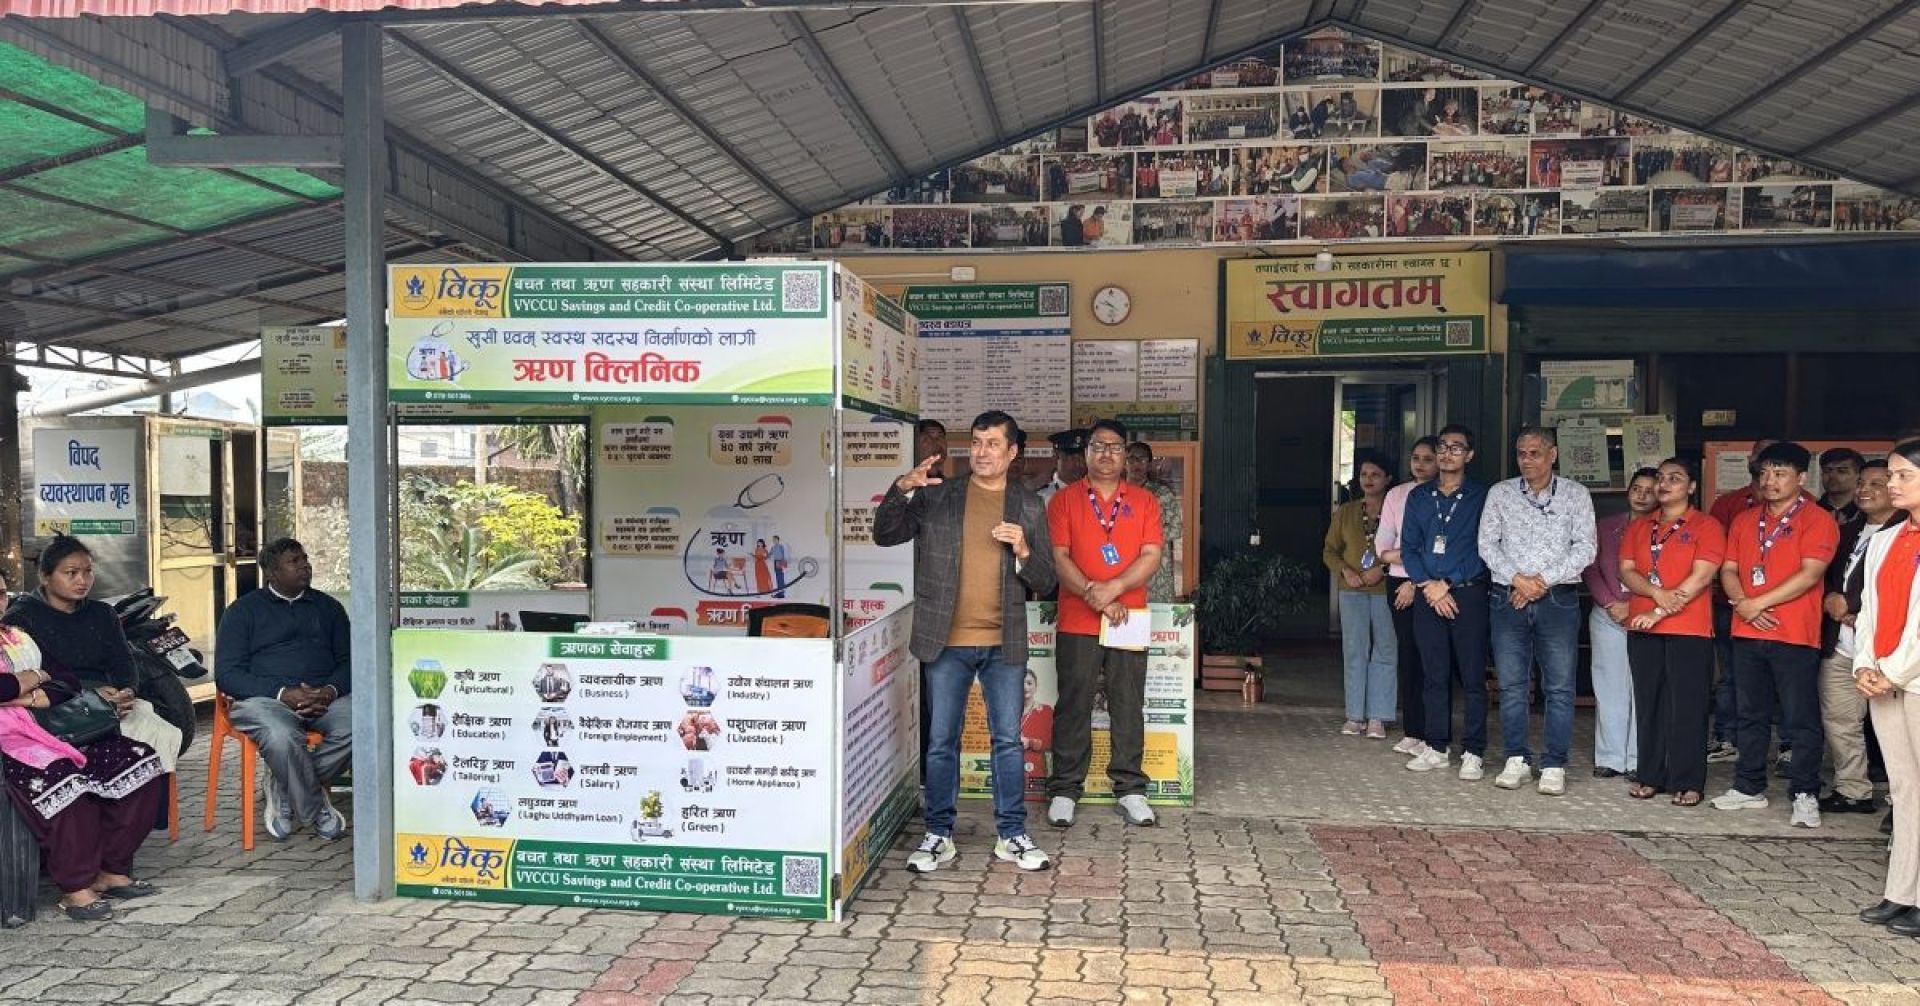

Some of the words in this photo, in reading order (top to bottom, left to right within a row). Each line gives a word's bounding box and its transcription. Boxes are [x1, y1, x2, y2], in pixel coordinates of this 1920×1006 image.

[437, 267, 502, 309] विकू
[514, 277, 544, 291] बचत
[551, 277, 577, 291] तथा
[584, 277, 614, 291] ऋण
[621, 274, 672, 293] सहकारी
[679, 275, 714, 292] संस्था
[720, 274, 776, 292] लिमिटेड
[1265, 275, 1447, 313] स्वागतम्
[514, 299, 557, 311] VYCCU
[561, 299, 605, 313] Savings
[610, 299, 631, 312] and
[634, 299, 671, 312] Credit
[674, 300, 749, 315] Co-operative
[753, 299, 777, 312] Ltd.
[465, 328, 498, 348] खुसी
[503, 331, 536, 347] एवम्
[542, 330, 585, 345] स्वस्थ
[592, 331, 639, 346] सदस्य
[644, 327, 714, 346] निर्माणको
[719, 329, 756, 346] लागी
[512, 359, 576, 382] ऋण
[584, 351, 702, 384] क्लिनिक
[68, 439, 101, 470] विपद्
[40, 483, 106, 504] व्यवस्थापन
[110, 483, 130, 509] गृह
[710, 531, 747, 547] ऋण
[706, 608, 739, 623] ऋण
[559, 642, 605, 655] ऋणका
[454, 668, 475, 684] कृषि
[478, 671, 501, 682] ऋण
[640, 676, 664, 686] ऋण
[793, 679, 814, 690] ऋण
[488, 717, 513, 727] ऋण
[652, 720, 672, 731] ऋण
[727, 719, 778, 733] पशुपालन
[781, 720, 807, 732] ऋण
[492, 760, 515, 770] ऋण
[614, 765, 638, 776] ऋण
[558, 799, 578, 808] ऋण
[681, 804, 708, 820] हरित
[712, 807, 736, 819] ऋण
[440, 837, 504, 880] विकू
[517, 850, 546, 865] बचत
[553, 852, 579, 866] तथा
[585, 853, 616, 867] ऋण
[622, 854, 673, 871] सहकारी
[680, 856, 715, 873] संस्था
[721, 856, 776, 876] लिमिटेड
[517, 870, 559, 884] VYCCU
[563, 872, 607, 889] Savings
[610, 876, 632, 889] and
[634, 876, 671, 890] Credit
[675, 879, 750, 895] Co-operative
[753, 882, 776, 895] Ltd.
